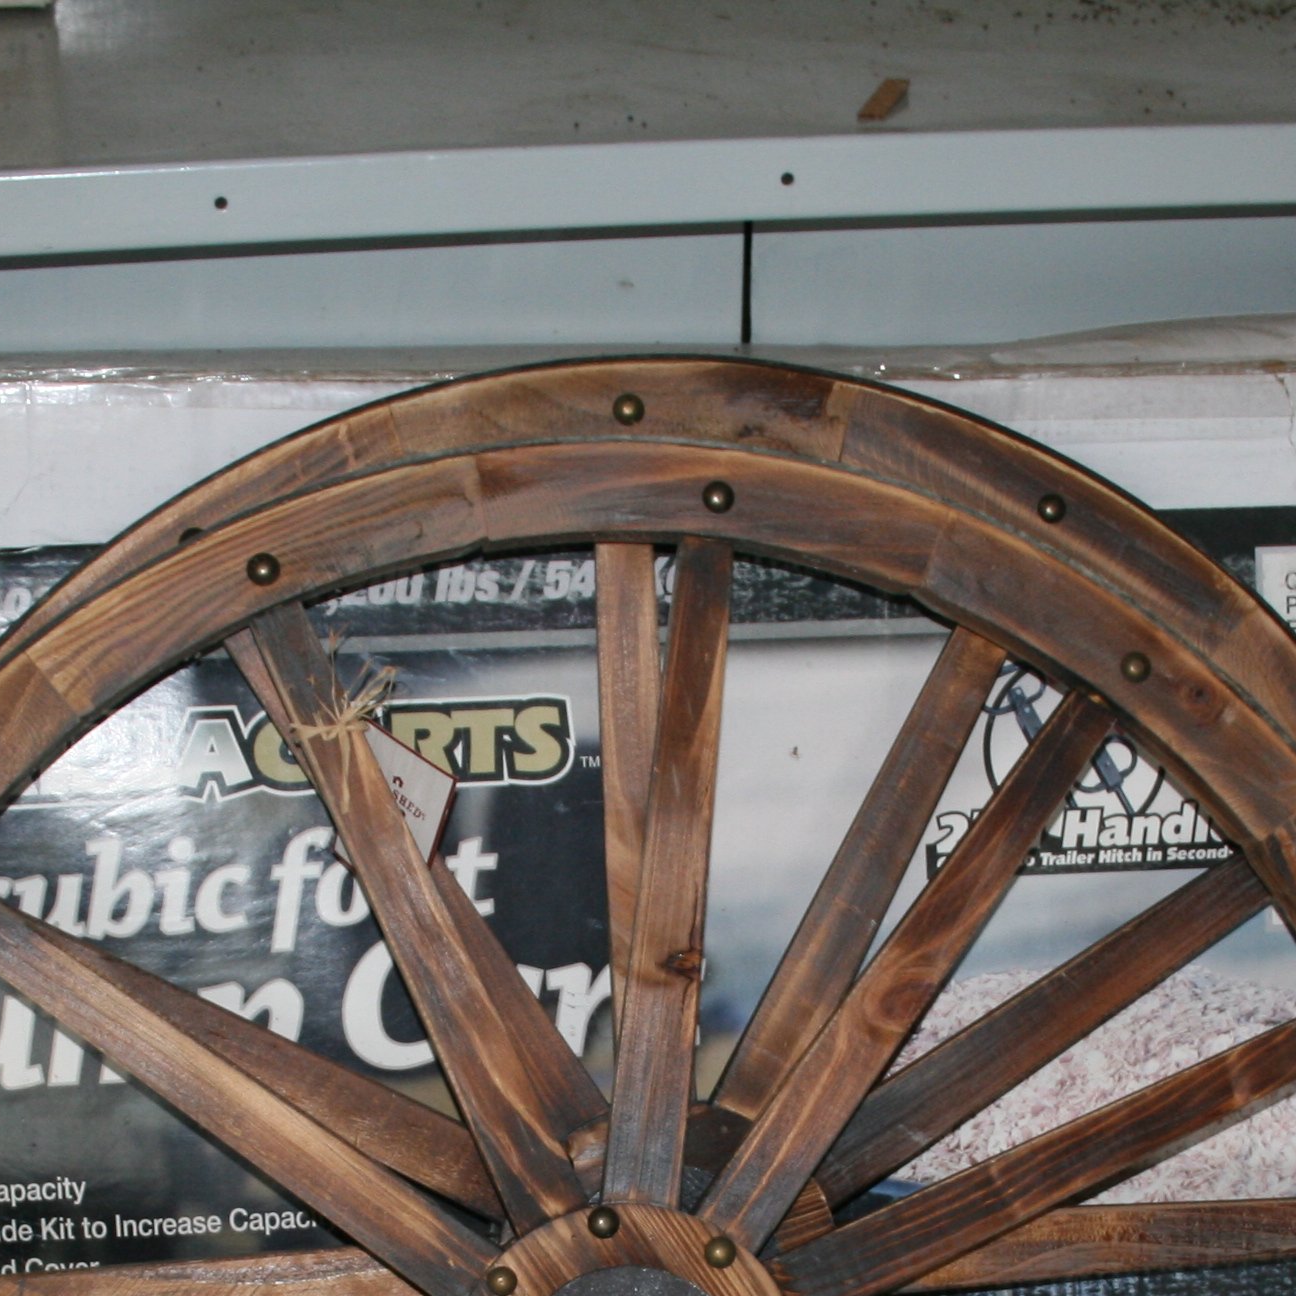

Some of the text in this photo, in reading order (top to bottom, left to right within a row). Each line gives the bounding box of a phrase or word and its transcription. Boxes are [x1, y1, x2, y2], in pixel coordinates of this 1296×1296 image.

[434, 564, 501, 602] lbs
[542, 560, 596, 600] 54
[253, 706, 562, 783] CRTS
[1040, 851, 1094, 866] Trailer
[1098, 849, 1141, 864] Hitch
[1147, 847, 1162, 862] in
[1167, 845, 1234, 862] Second
[270, 826, 499, 953] fot
[40, 1217, 75, 1240] Kit
[81, 1217, 108, 1239] to
[115, 1214, 222, 1237] Increase
[229, 1207, 317, 1235] Capac
